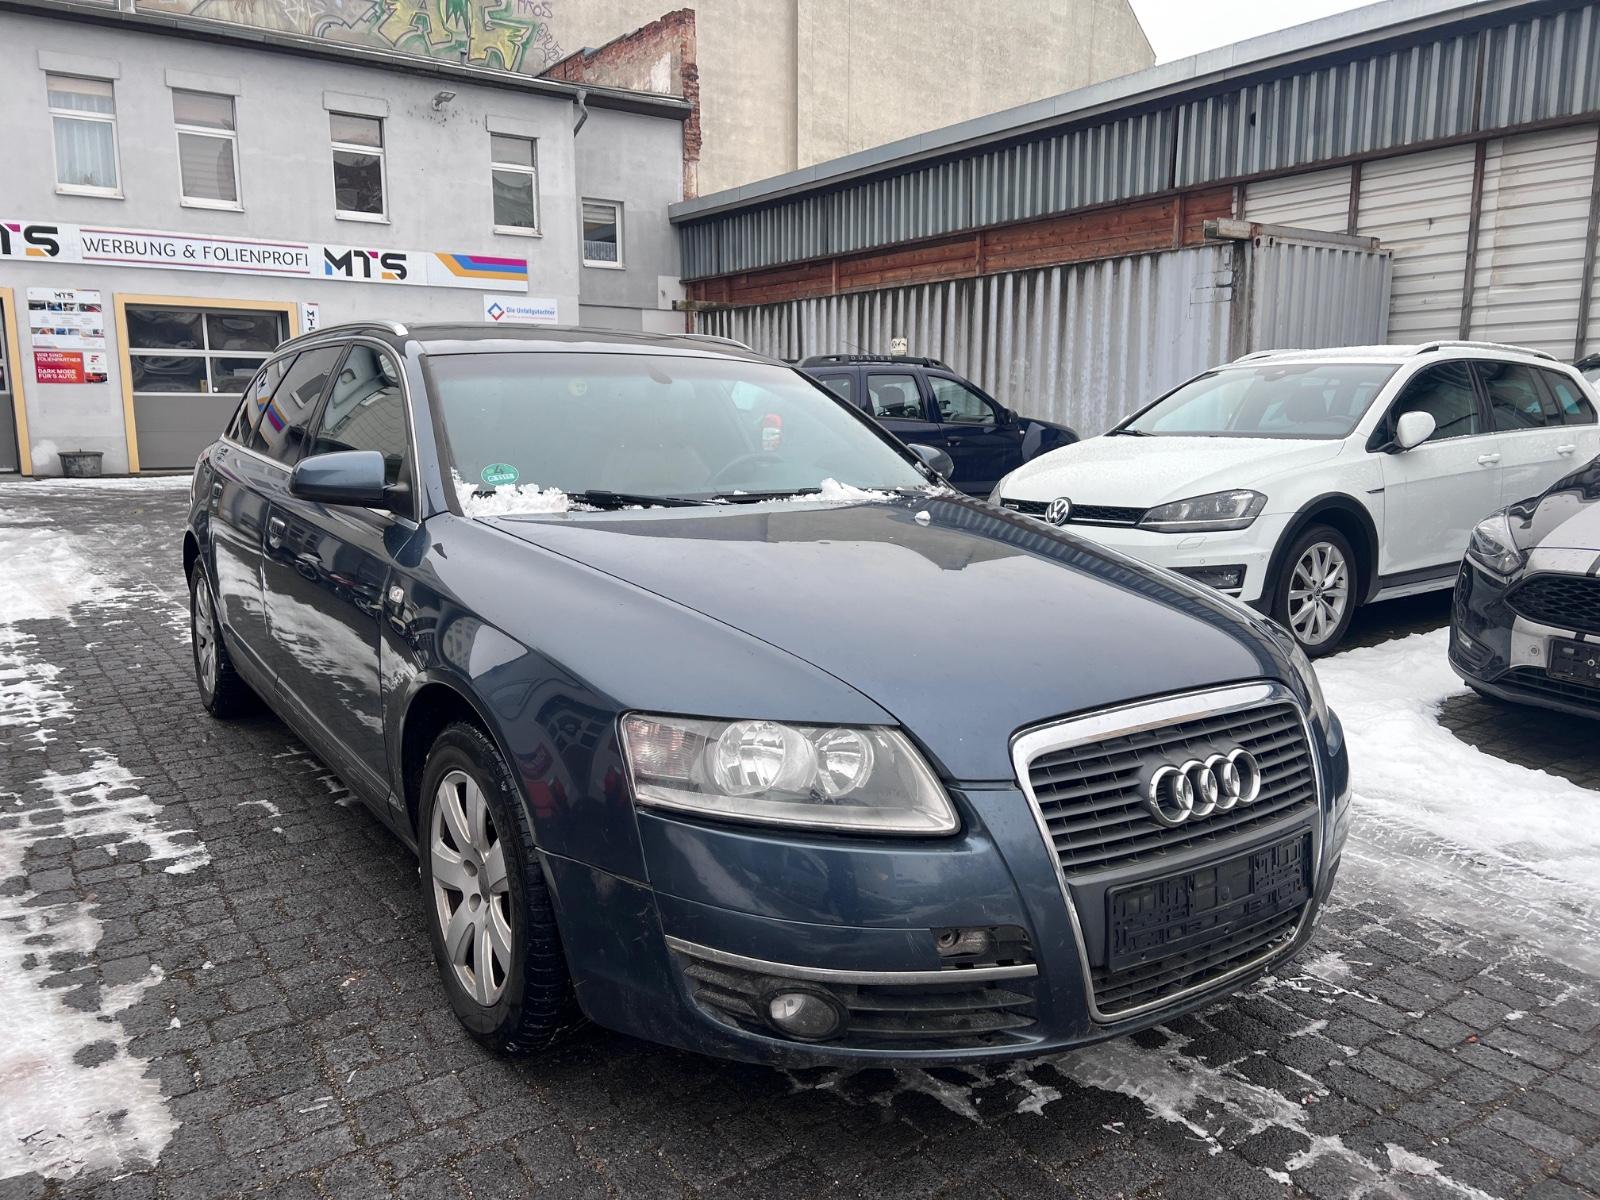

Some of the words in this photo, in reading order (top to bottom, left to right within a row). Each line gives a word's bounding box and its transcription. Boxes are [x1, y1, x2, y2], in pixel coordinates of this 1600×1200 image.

[82, 237, 176, 257] WERBUNG
[183, 244, 196, 259] &
[203, 246, 309, 267] FOLIENPROFI
[324, 247, 407, 280] MTS
